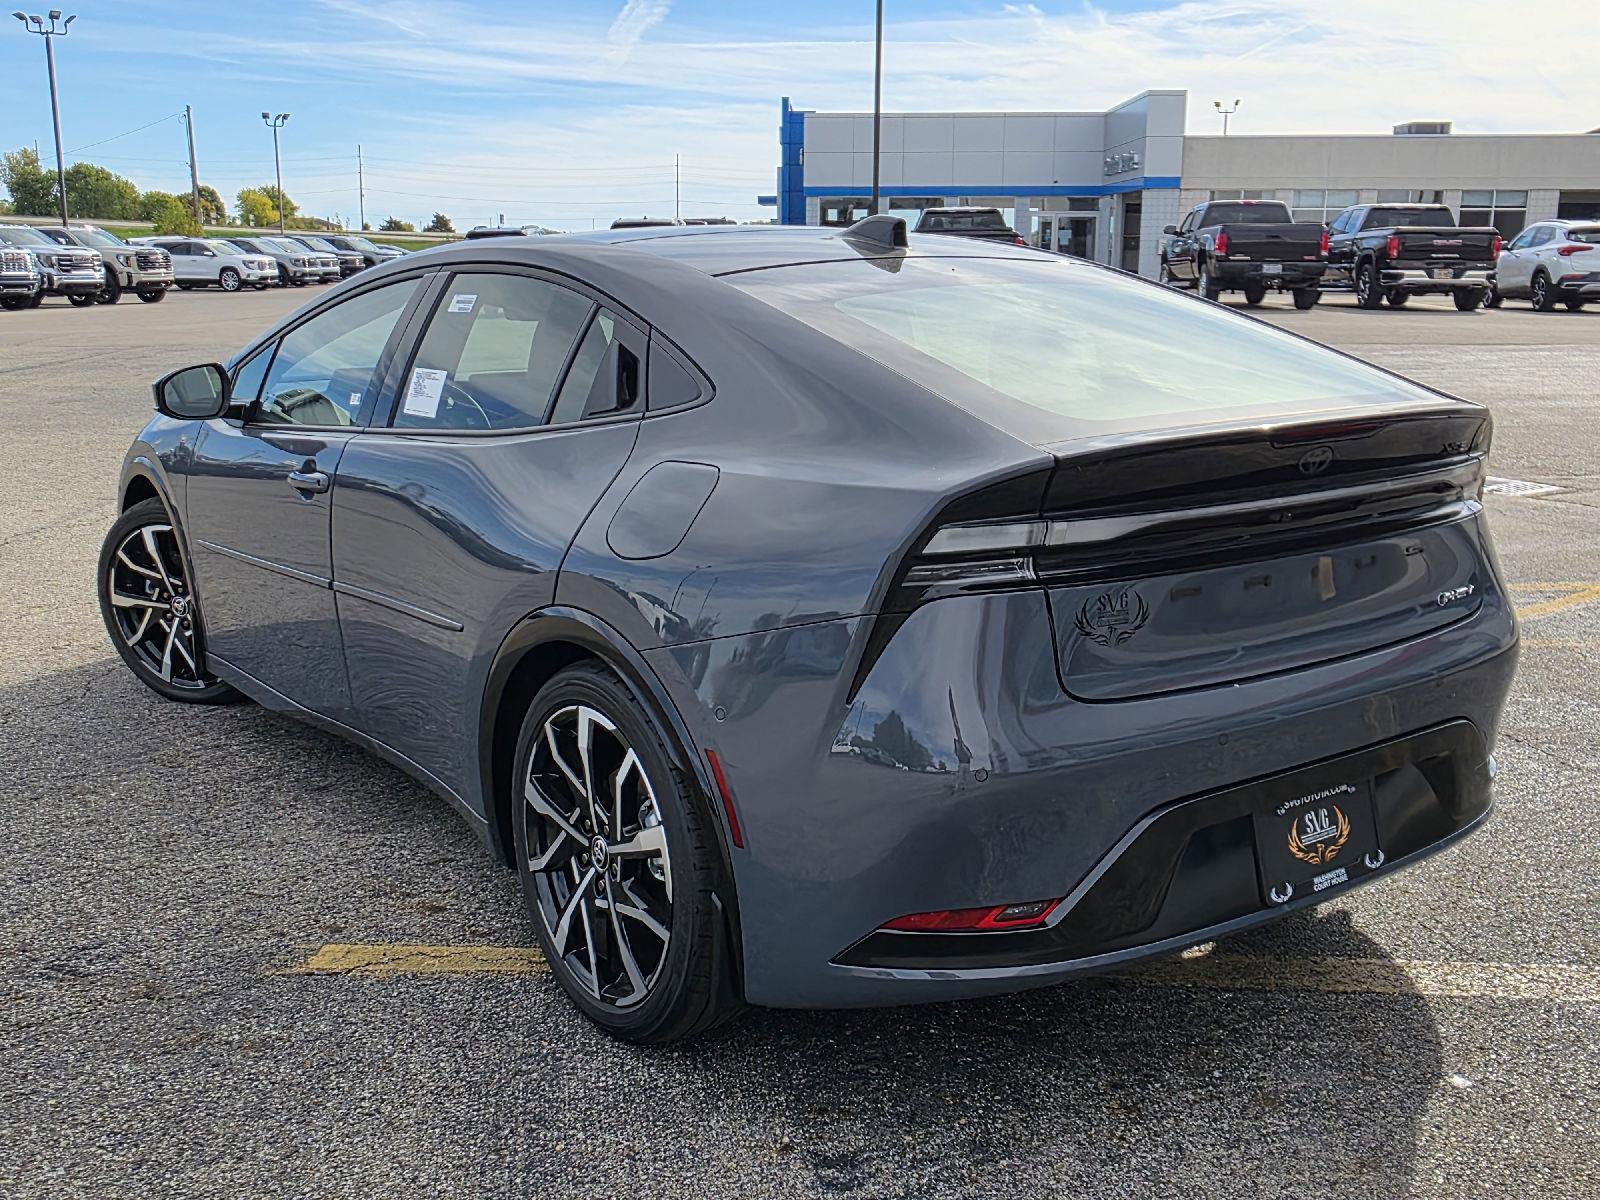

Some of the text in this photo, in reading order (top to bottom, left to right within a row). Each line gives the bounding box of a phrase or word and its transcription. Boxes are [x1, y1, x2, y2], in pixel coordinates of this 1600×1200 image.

[1098, 592, 1129, 613] SVG
[1305, 808, 1330, 834] SVG
[1313, 867, 1346, 885] WASHINGTON
[1313, 879, 1331, 892] COURT
